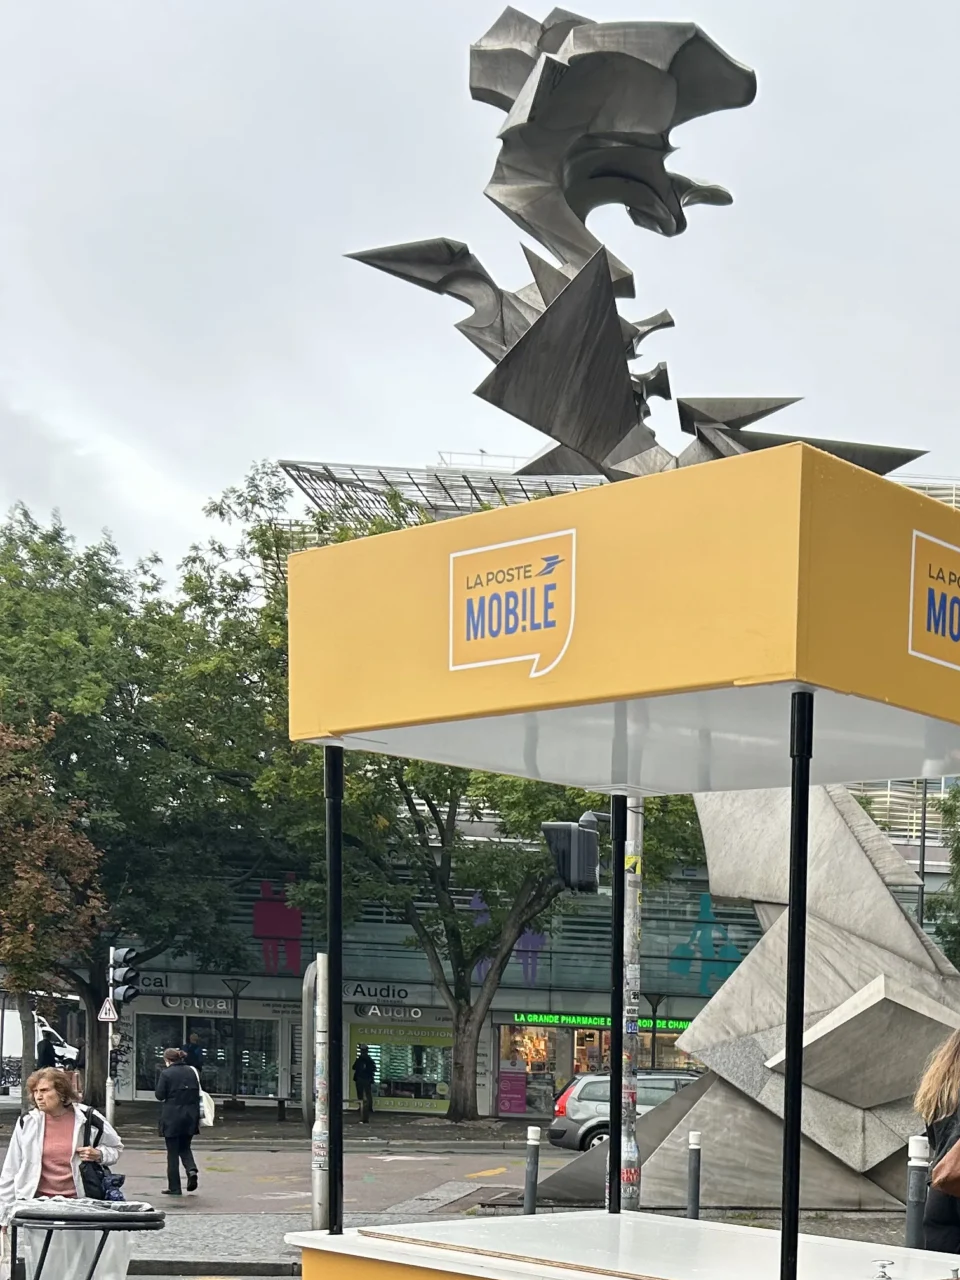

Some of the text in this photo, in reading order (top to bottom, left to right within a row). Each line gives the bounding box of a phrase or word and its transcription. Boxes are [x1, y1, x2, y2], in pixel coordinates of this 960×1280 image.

[466, 564, 532, 590] LA POSTE
[928, 563, 946, 584] LA
[353, 983, 408, 999] Audio
[167, 995, 232, 1010] Optical
[368, 1005, 422, 1019] Audio
[514, 1013, 526, 1023] LA
[527, 1014, 560, 1025] GRANDE
[561, 1015, 605, 1026] PHARMACIE
[656, 1020, 667, 1030] DE
[668, 1020, 693, 1030] CHAVA
[358, 1027, 394, 1036] CENTRE
